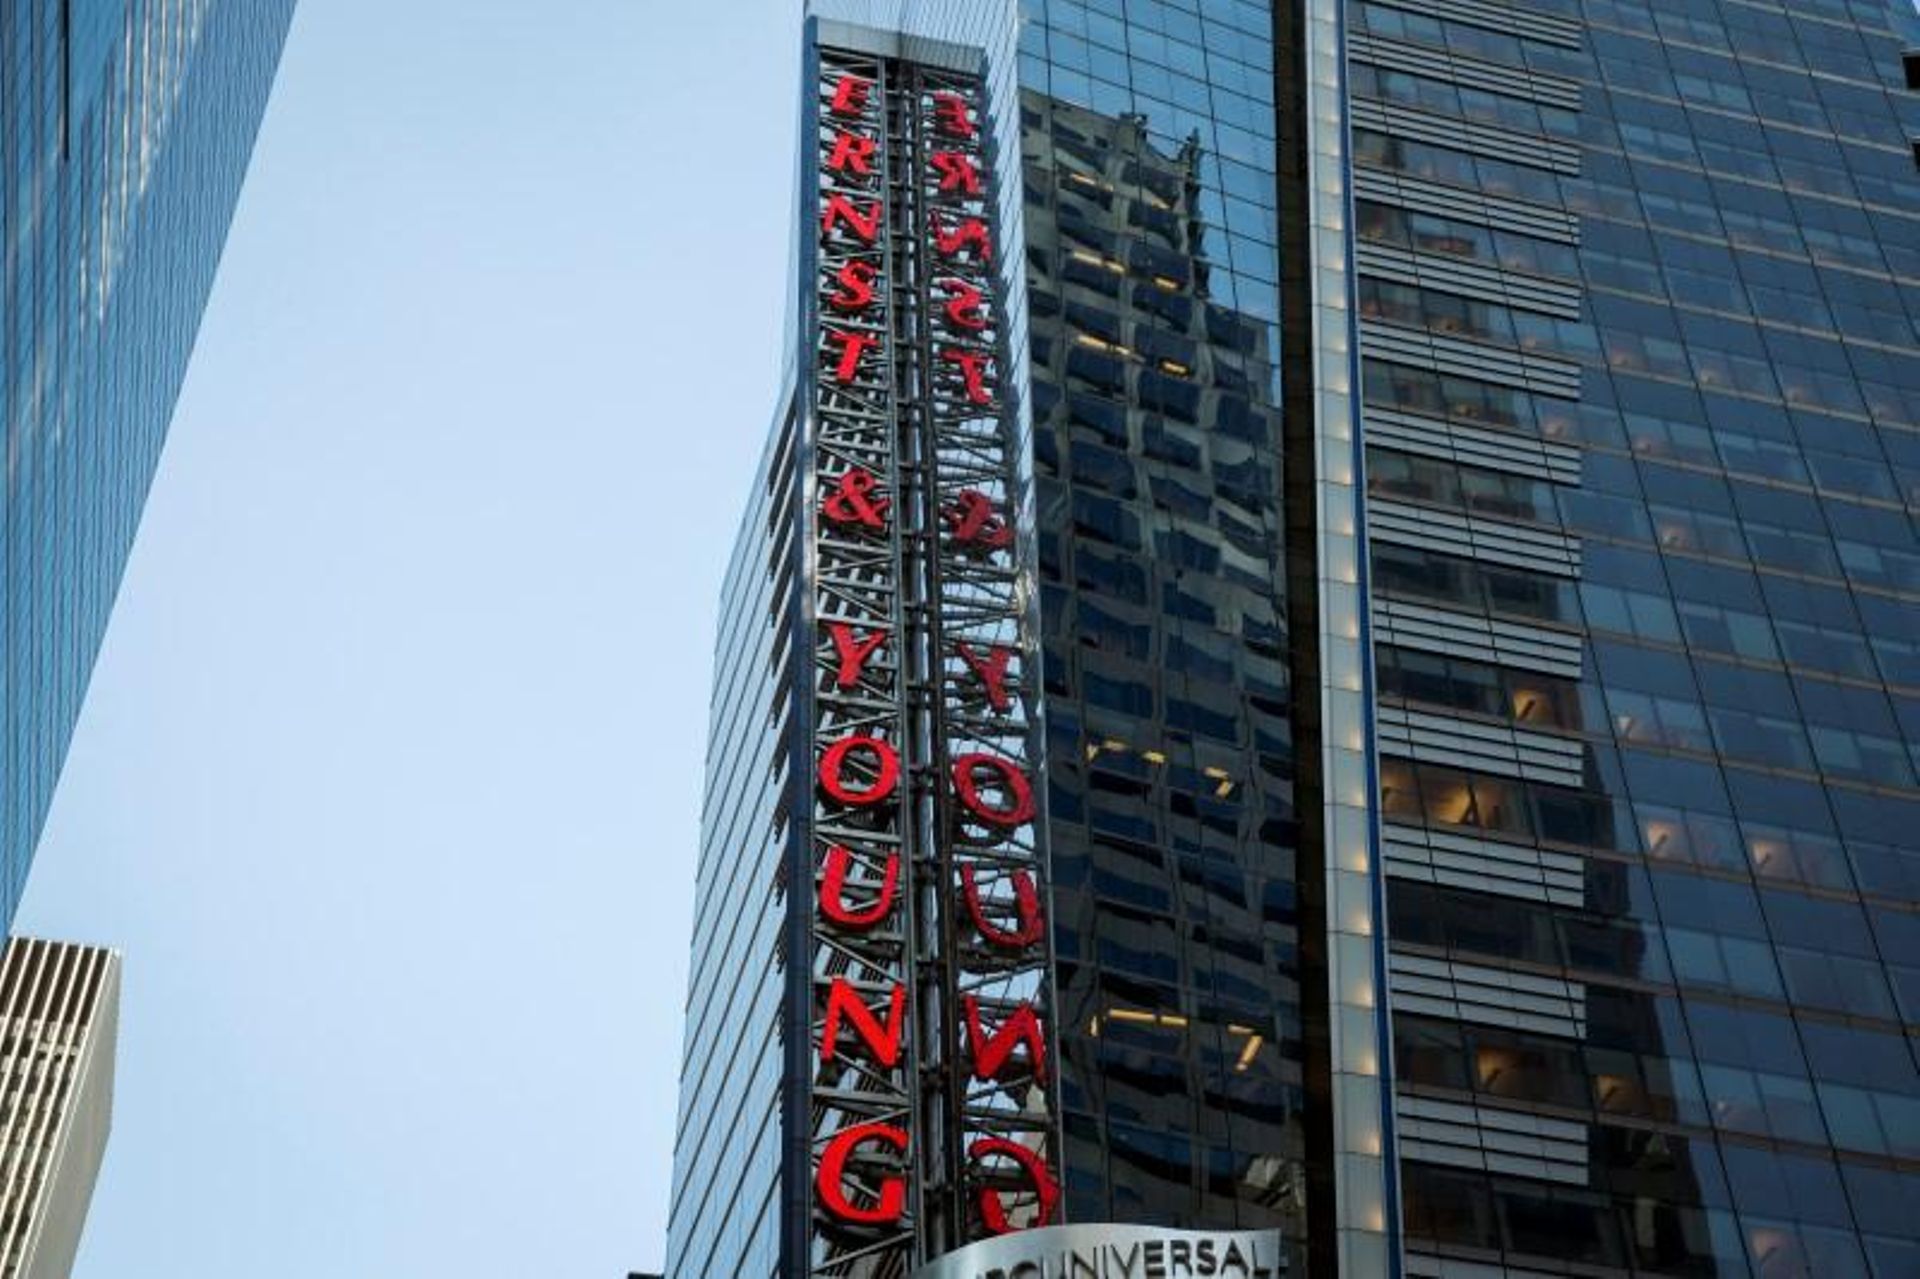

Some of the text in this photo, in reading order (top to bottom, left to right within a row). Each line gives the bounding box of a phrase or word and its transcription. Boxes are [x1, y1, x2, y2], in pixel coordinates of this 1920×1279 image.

[816, 75, 910, 1224] ERNST & YOUNG
